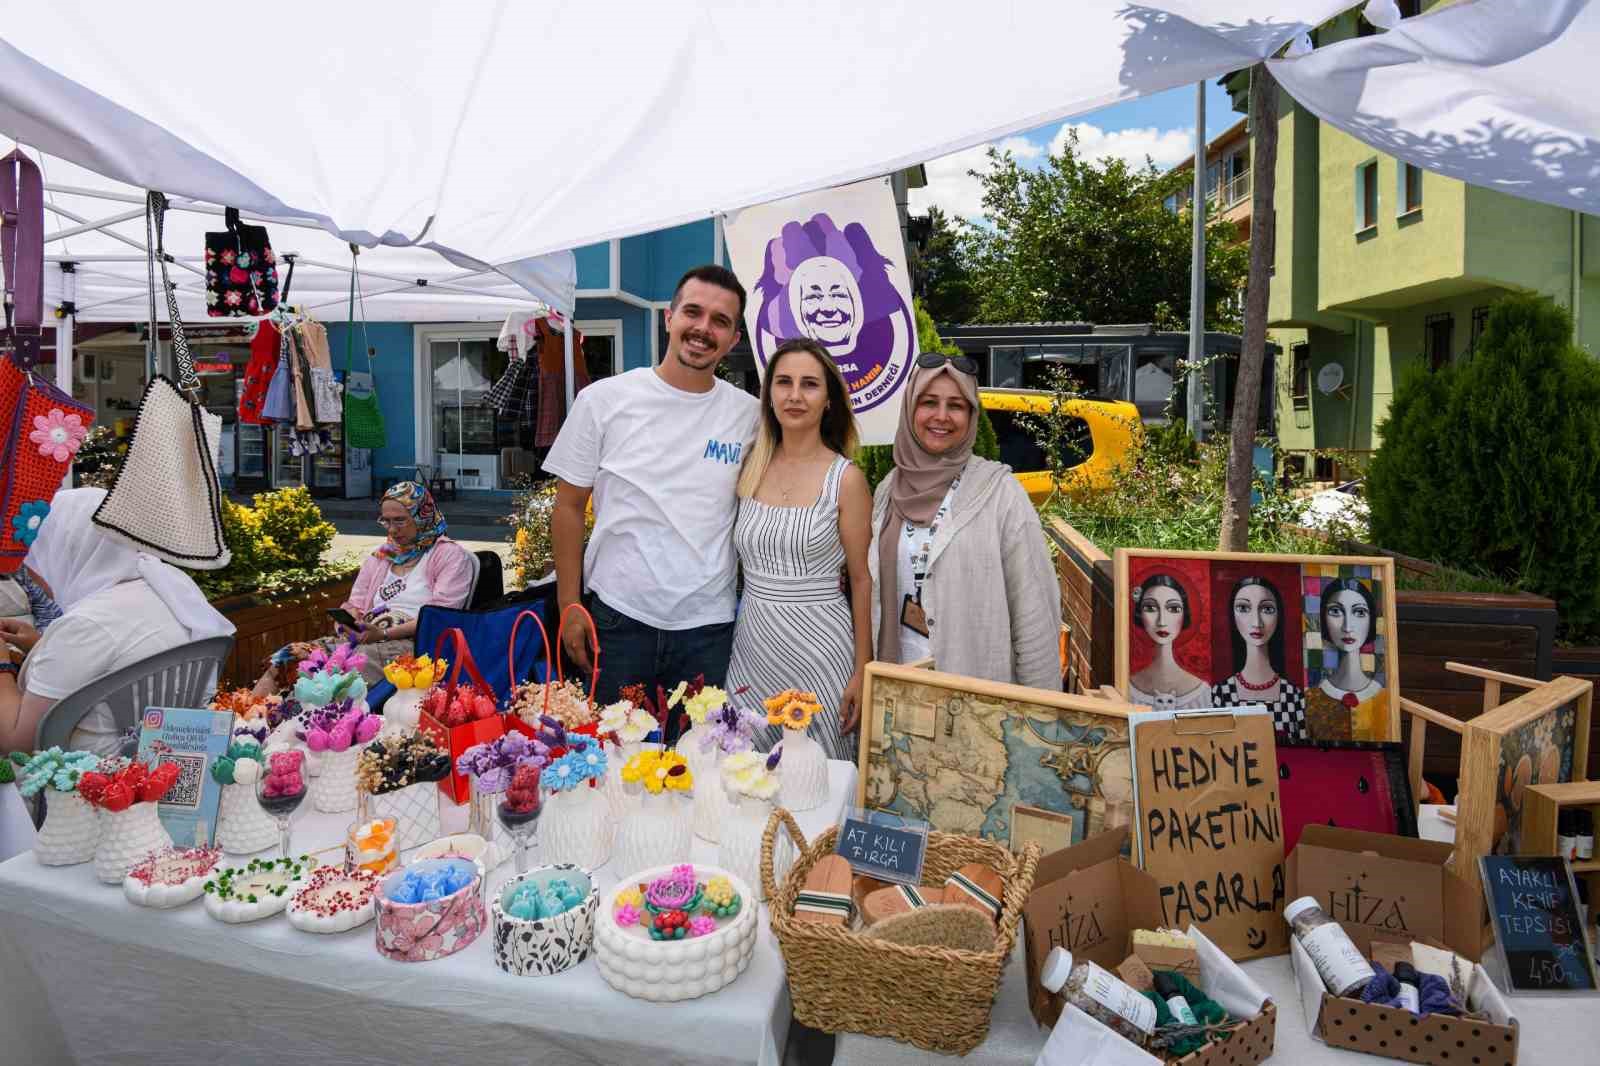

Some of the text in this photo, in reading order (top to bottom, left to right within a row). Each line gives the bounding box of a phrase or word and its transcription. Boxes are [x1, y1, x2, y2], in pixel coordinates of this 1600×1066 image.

[1151, 740, 1263, 792] HEDİYE
[848, 828, 868, 845] AT
[1148, 792, 1280, 852] PAKETİNİ
[1160, 864, 1285, 926] TASARLA
